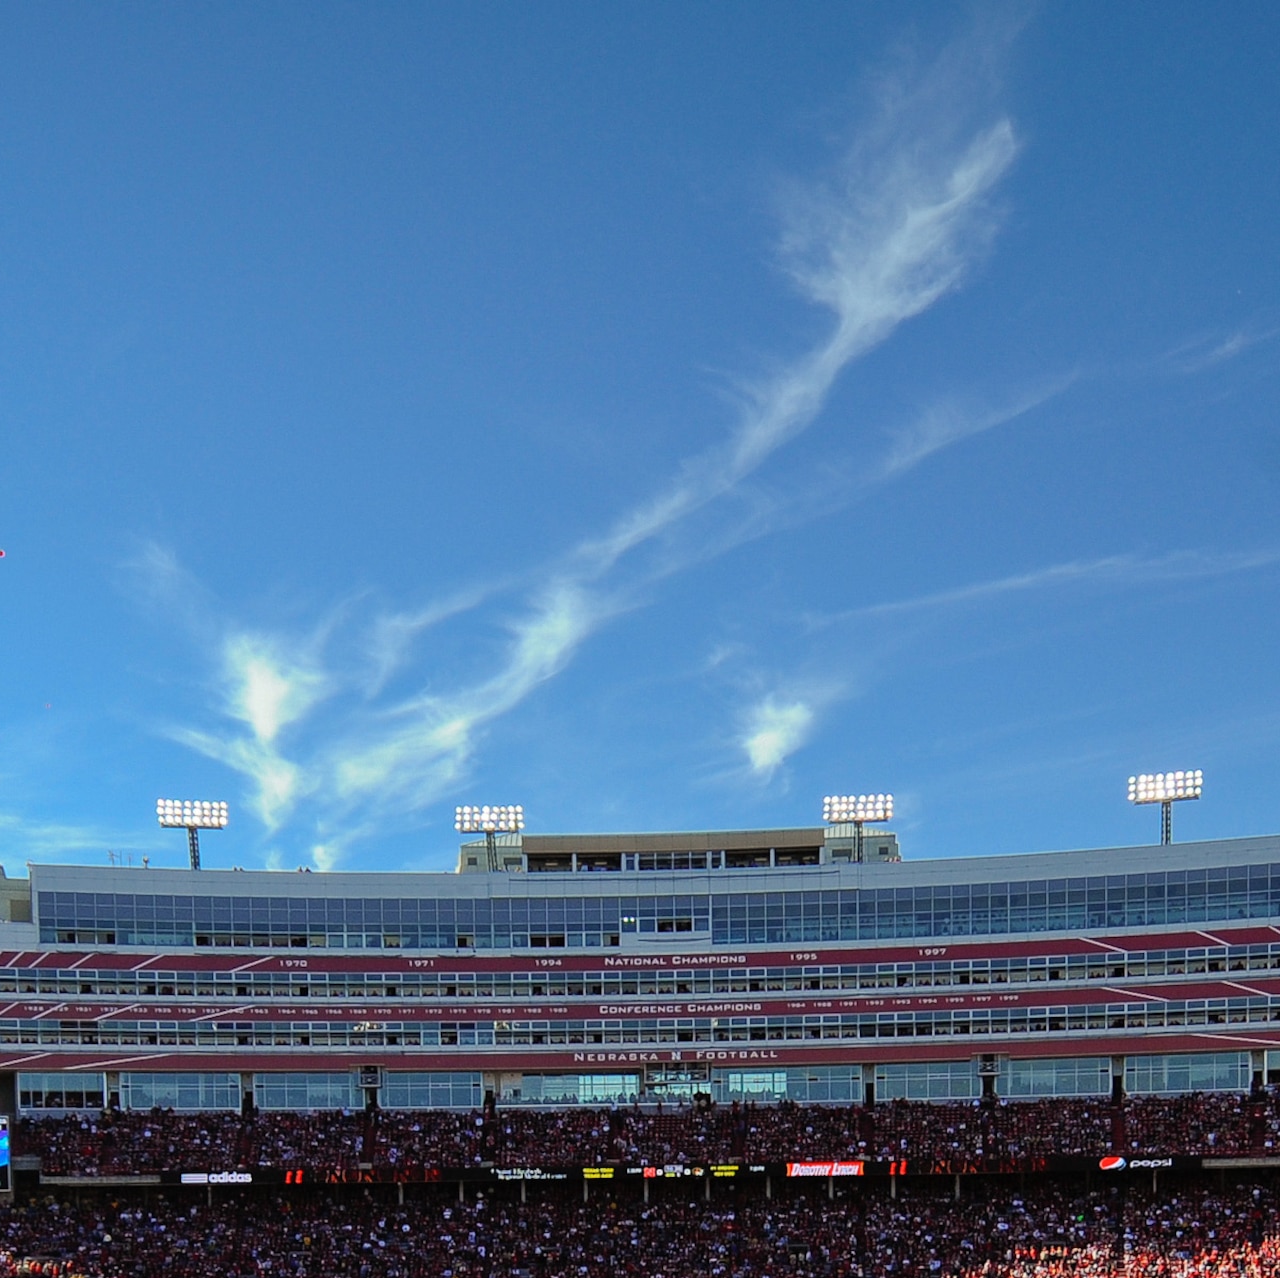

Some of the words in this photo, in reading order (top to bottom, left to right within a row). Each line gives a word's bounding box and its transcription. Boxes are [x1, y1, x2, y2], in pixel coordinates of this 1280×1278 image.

[280, 959, 307, 967] 1970
[409, 959, 434, 967] 1971
[535, 959, 562, 967] 1994
[790, 952, 817, 961] 1995
[918, 948, 946, 956] 1997
[574, 1052, 658, 1062] NEBRASKA
[696, 1050, 778, 1060] FOOTBALL
[1130, 1157, 1173, 1168] pepsi
[209, 1172, 252, 1183] adidas
